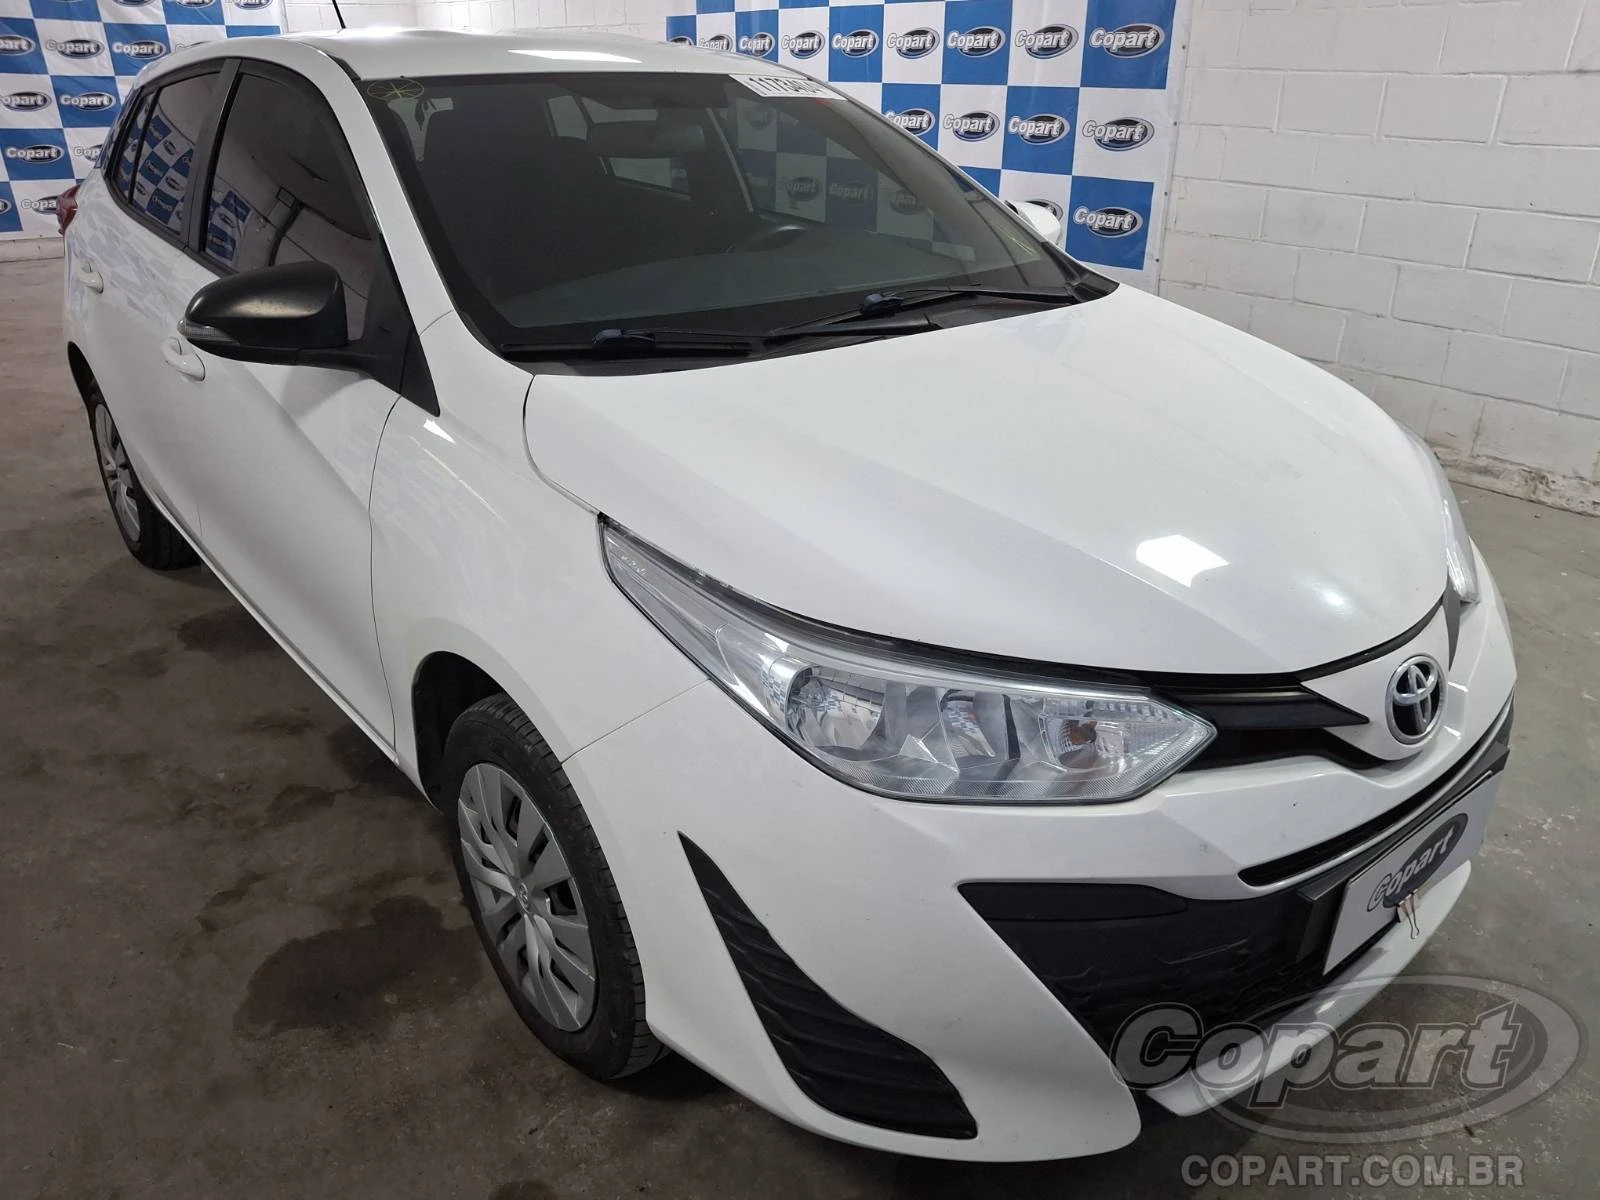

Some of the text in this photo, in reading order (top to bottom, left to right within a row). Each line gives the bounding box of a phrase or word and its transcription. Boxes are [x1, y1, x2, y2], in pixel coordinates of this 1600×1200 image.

[0, 38, 28, 51] art
[45, 39, 97, 54] Copart
[738, 36, 771, 52] Copart
[781, 35, 820, 53] Copart
[832, 33, 874, 52] Copart
[887, 33, 935, 52] Copart
[947, 31, 999, 51] Copart
[1014, 30, 1070, 51] Copart
[1089, 27, 1157, 50] Copart
[112, 41, 160, 55] Copart
[0, 93, 46, 108] opart
[60, 93, 111, 108] Copart
[943, 114, 993, 134] Copart
[1007, 116, 1062, 136] Copart
[1082, 120, 1144, 142] Copart
[6, 146, 58, 160] Copart
[74, 146, 102, 160] Cop
[21, 198, 57, 212] Copa
[1073, 206, 1134, 231] Copart
[1367, 825, 1456, 912] Copart
